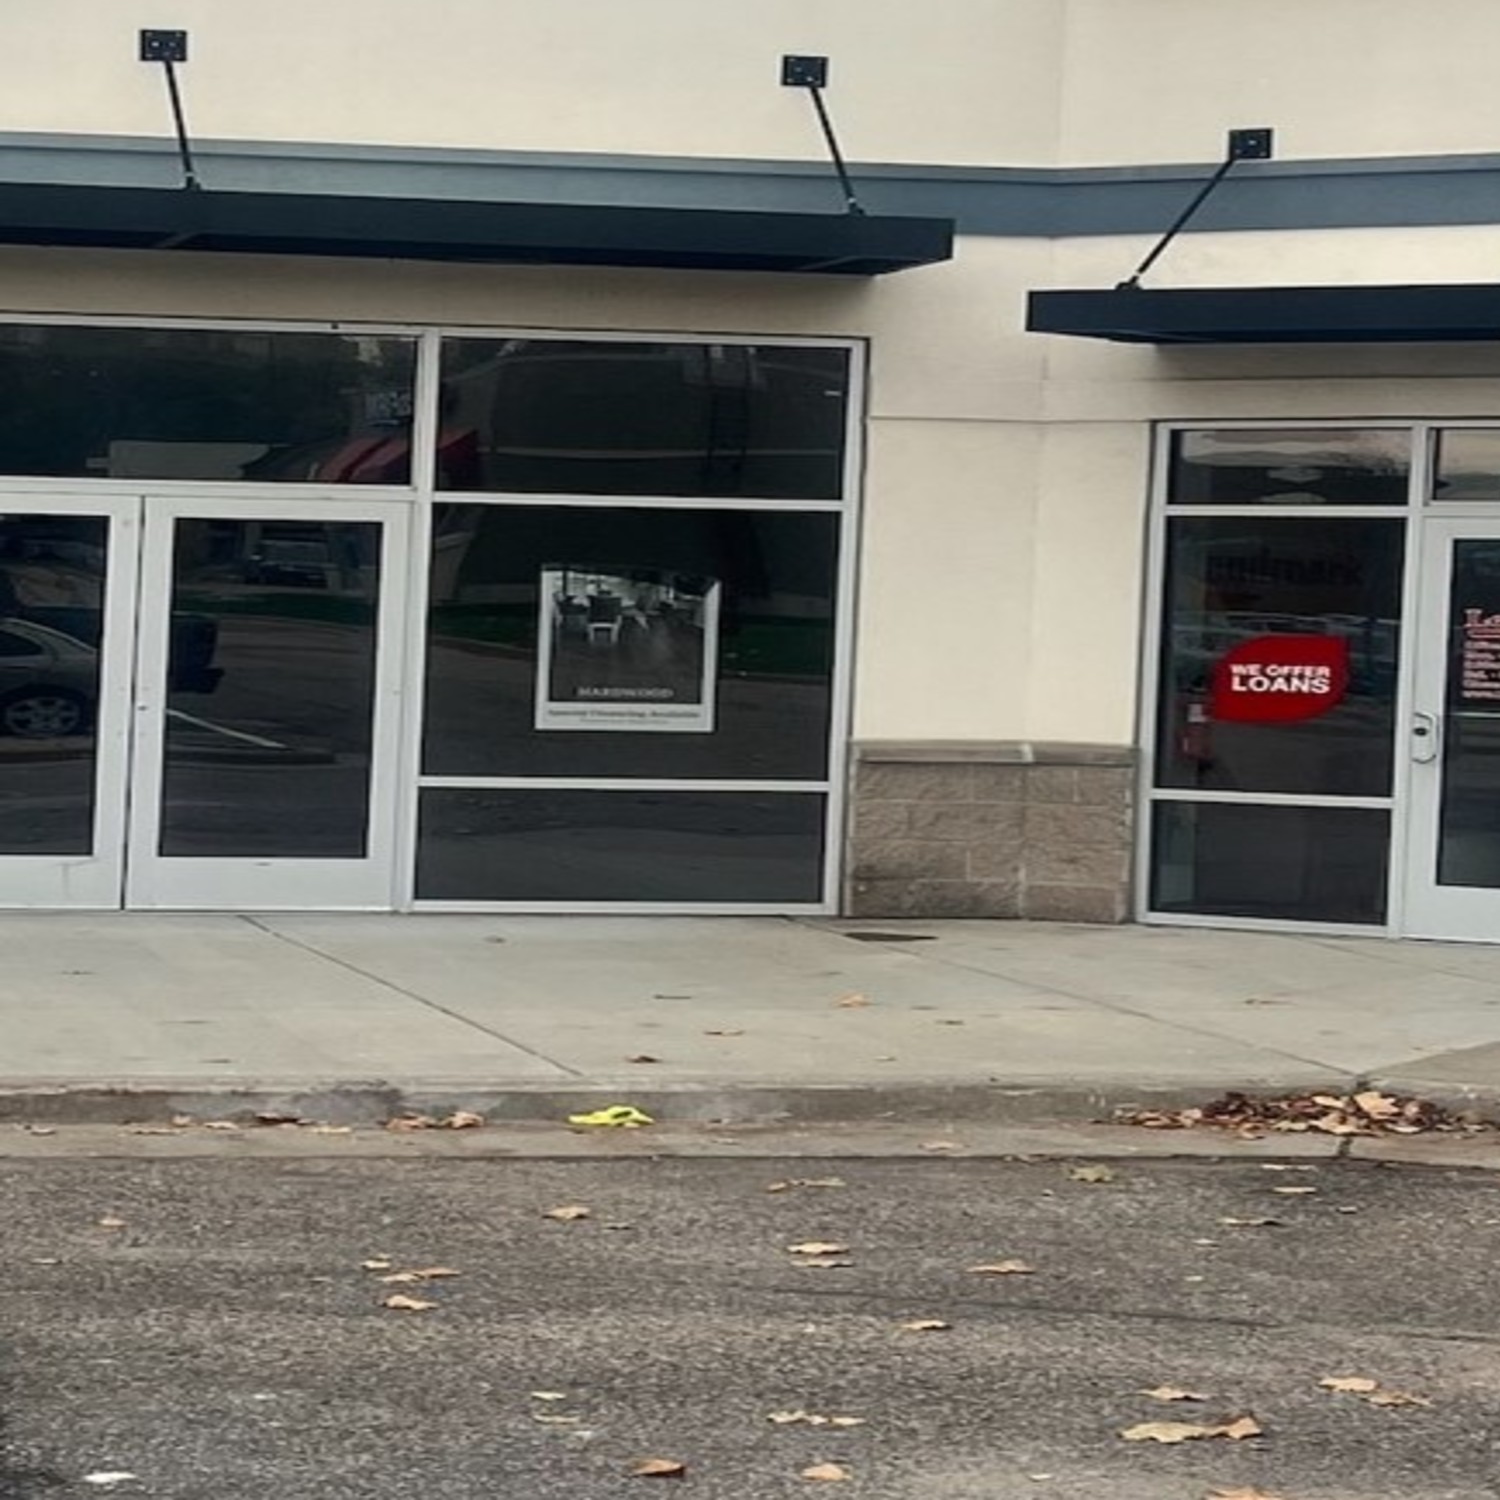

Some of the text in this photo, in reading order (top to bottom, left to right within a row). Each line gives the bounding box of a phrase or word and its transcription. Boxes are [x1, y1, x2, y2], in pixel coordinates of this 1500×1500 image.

[1229, 663, 1331, 678] WE OFFER
[1231, 674, 1331, 694] LOANS
